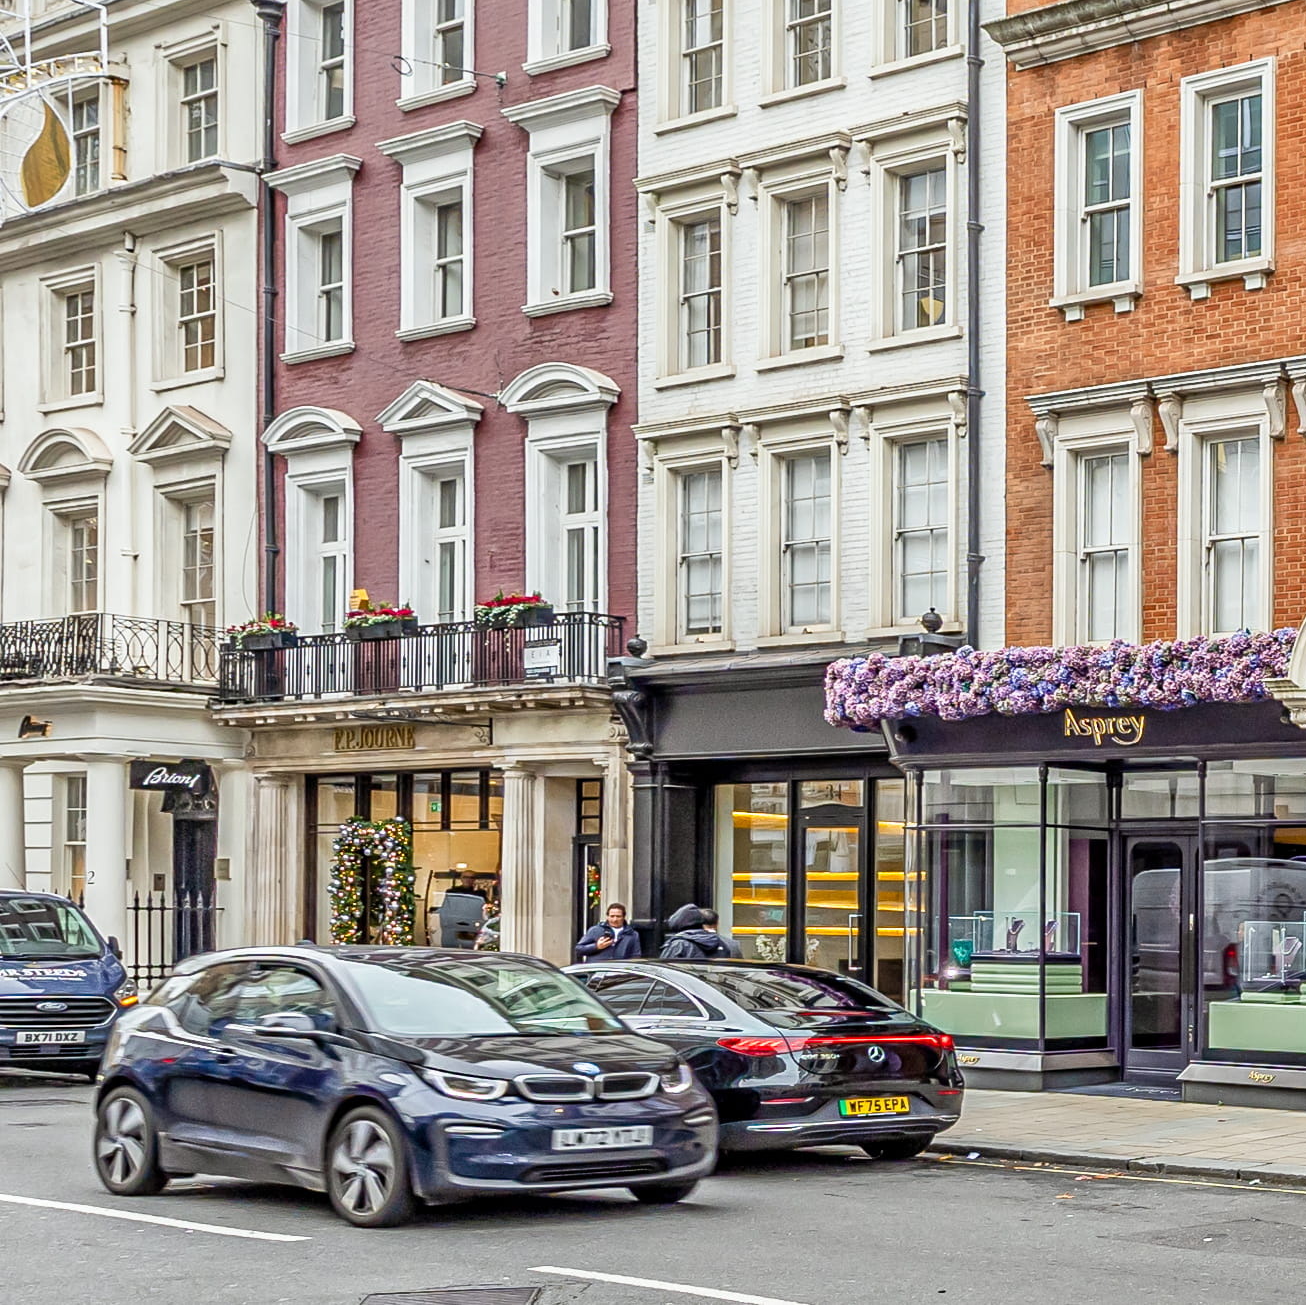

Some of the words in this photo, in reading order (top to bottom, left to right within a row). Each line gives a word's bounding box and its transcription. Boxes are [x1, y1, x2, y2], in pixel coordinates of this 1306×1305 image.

[1064, 708, 1145, 746] Asprey
[143, 766, 201, 788] Brioni
[87, 870, 95, 884] 2
[25, 1033, 52, 1042] BX71
[56, 1033, 78, 1042] DXZ
[1248, 1070, 1276, 1083] Asprey
[849, 1099, 882, 1112] WF75
[884, 1098, 907, 1111] EPA
